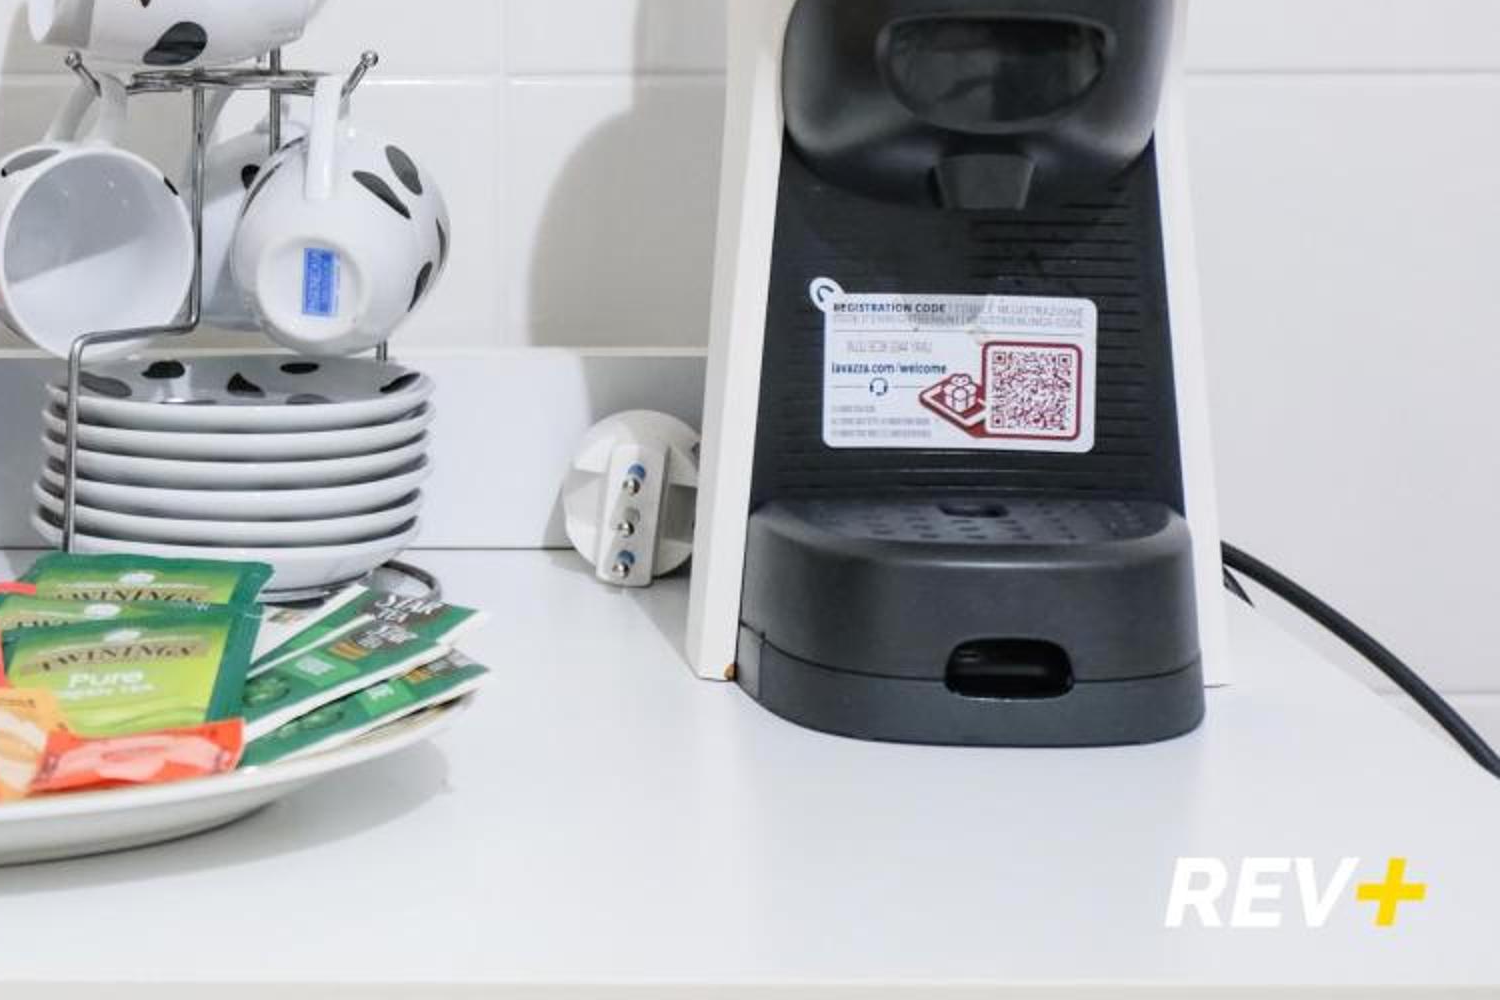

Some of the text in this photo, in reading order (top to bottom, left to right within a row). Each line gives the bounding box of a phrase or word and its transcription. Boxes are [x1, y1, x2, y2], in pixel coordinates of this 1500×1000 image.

[833, 302, 913, 313] REGISTRATION
[914, 302, 947, 313] CODE
[68, 670, 144, 690] Pure
